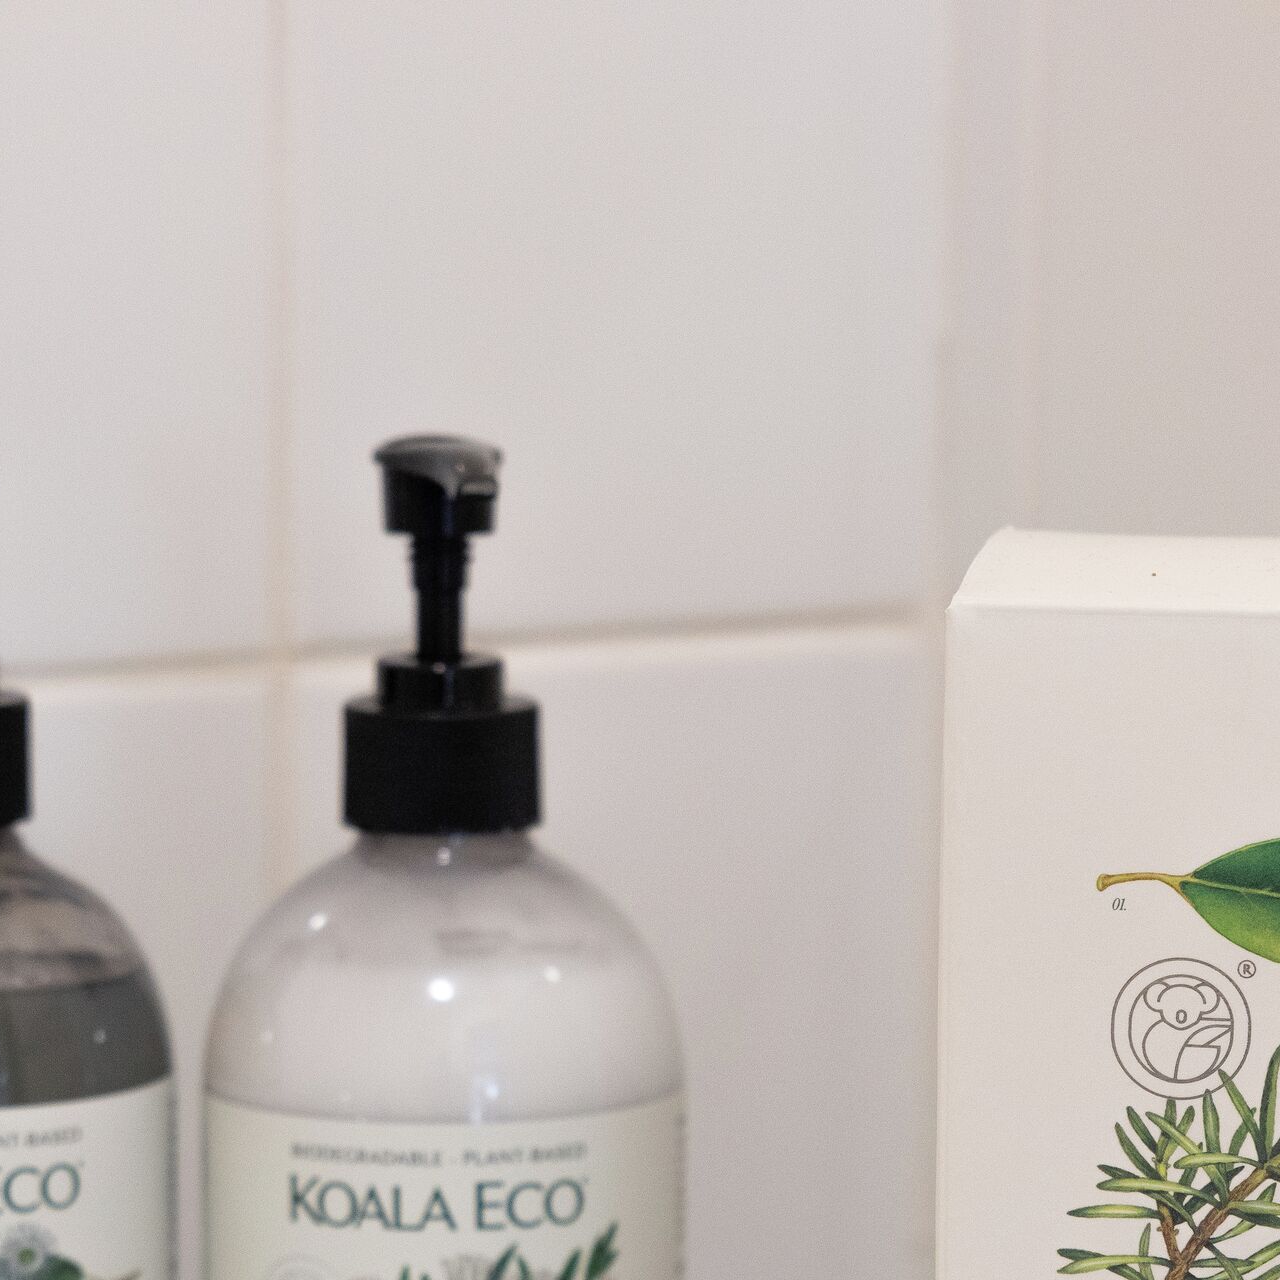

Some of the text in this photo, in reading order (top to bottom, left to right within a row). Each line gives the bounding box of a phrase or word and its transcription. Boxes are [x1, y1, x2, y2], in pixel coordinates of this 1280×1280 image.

[1111, 897, 1127, 911] 01.
[289, 1172, 585, 1232] KOALA ECO
